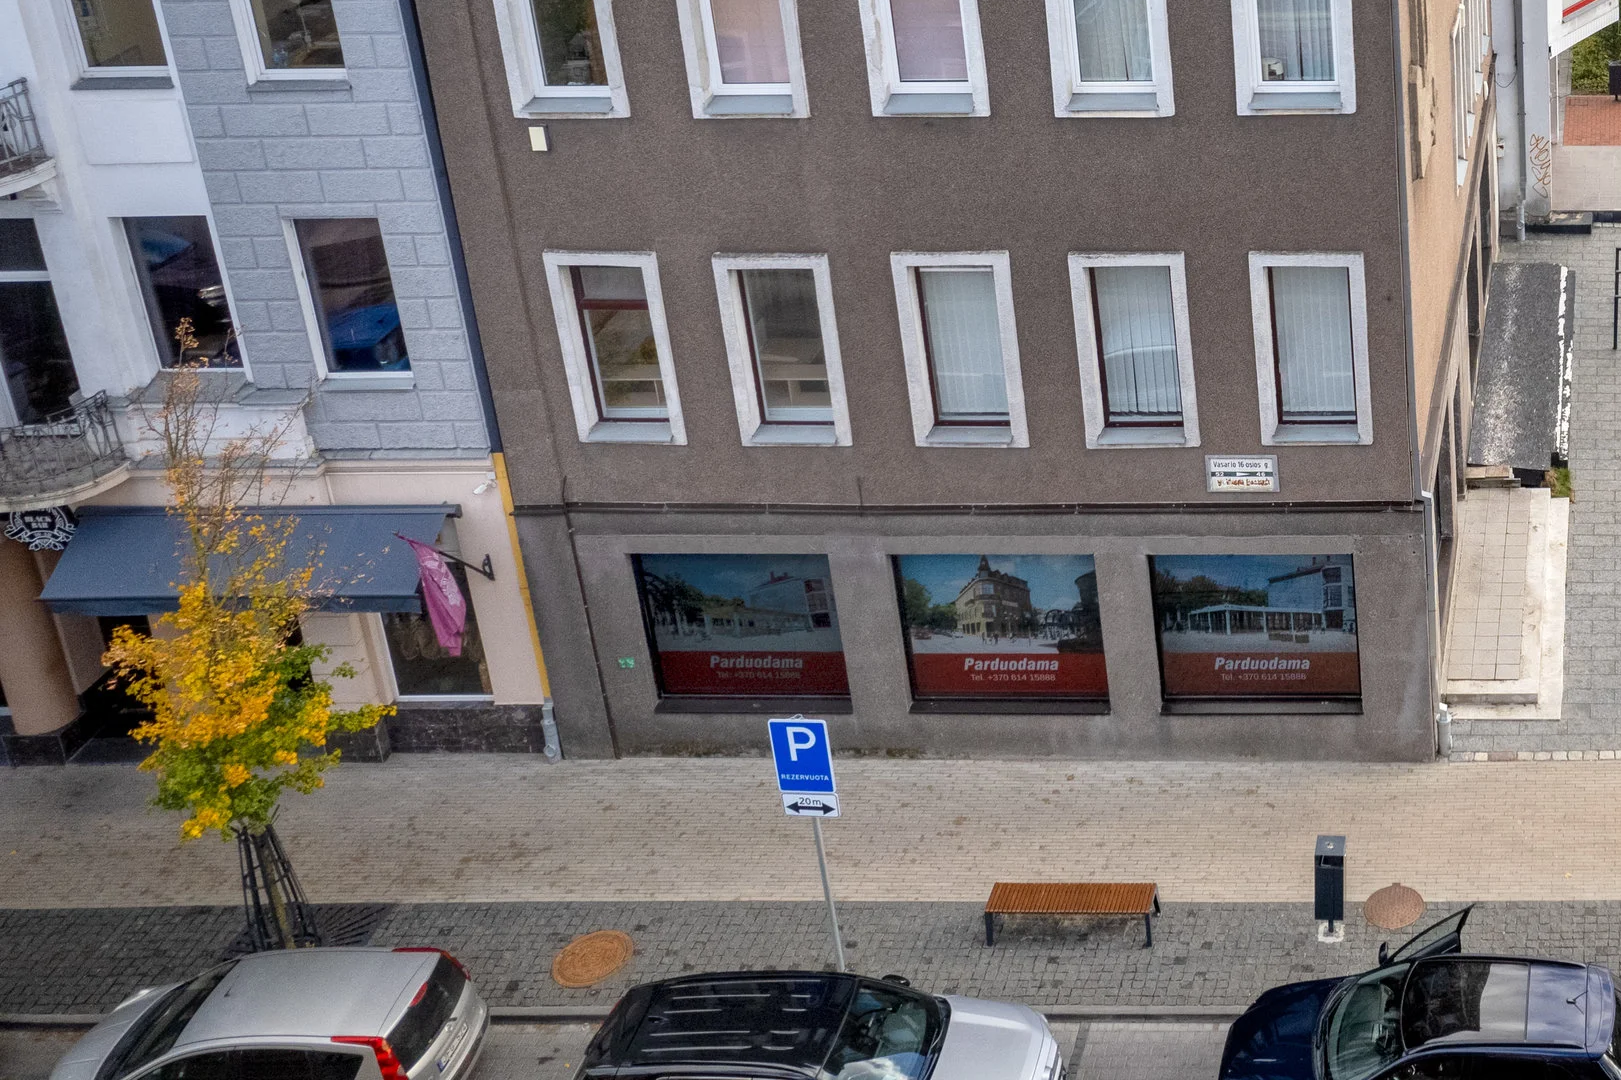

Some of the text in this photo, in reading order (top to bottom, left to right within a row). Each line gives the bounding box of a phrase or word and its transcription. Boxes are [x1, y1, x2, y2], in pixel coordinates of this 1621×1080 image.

[710, 655, 803, 669] Parduodama
[964, 657, 1059, 671] Parduodama
[1214, 656, 1311, 671] Parduodama
[1010, 673, 1027, 681] 614
[1220, 673, 1234, 681] Tel.
[1238, 673, 1260, 681] +370
[1261, 673, 1278, 681] 614
[786, 726, 817, 762] P
[781, 773, 830, 781] REZERVUOTA
